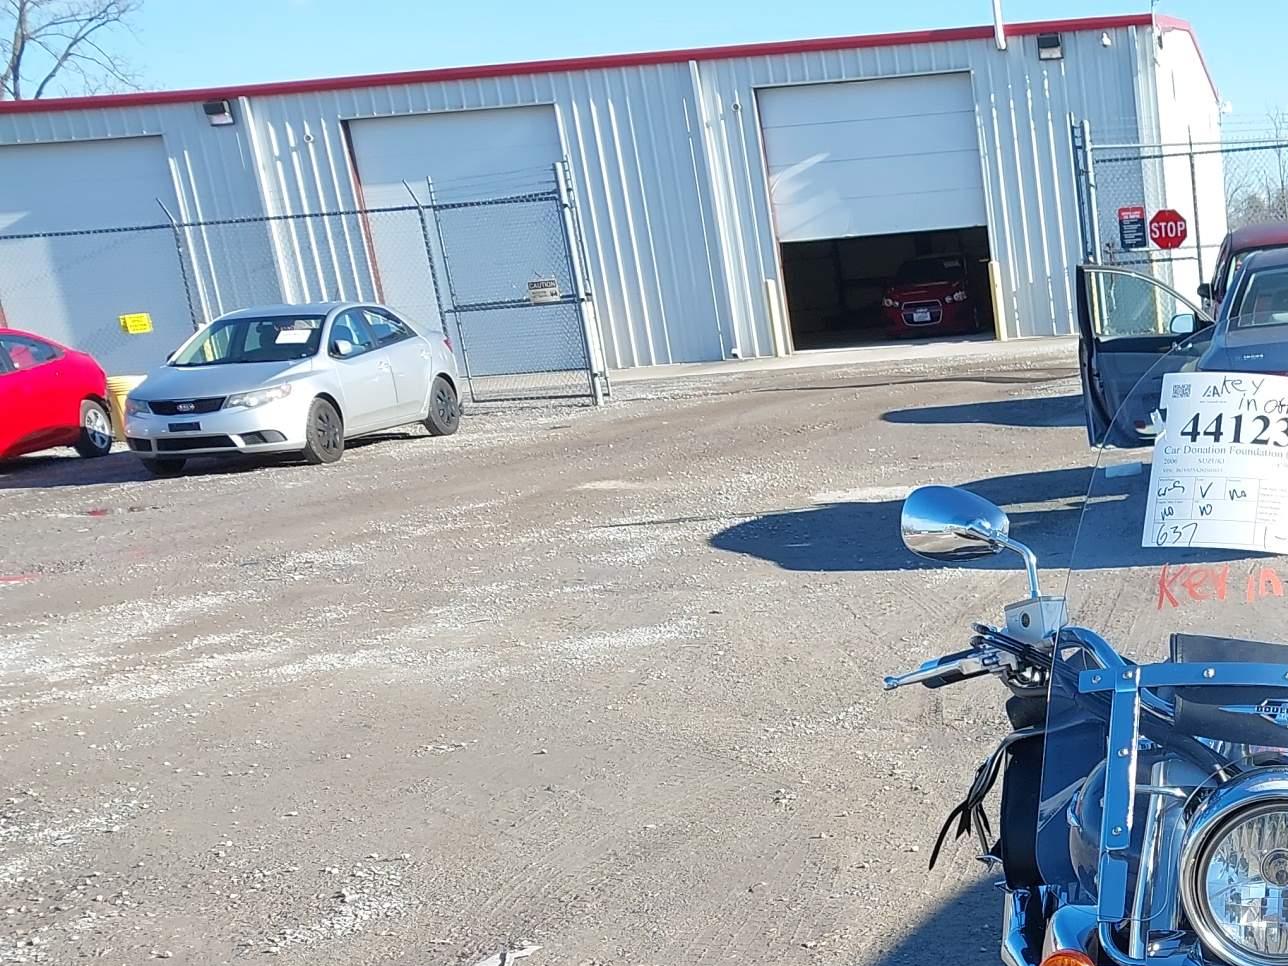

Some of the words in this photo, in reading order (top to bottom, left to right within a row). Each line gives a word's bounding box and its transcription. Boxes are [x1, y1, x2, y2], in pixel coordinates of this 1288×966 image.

[1151, 222, 1185, 238] STOP
[1164, 446, 1180, 455] Car
[1183, 445, 1226, 455] Donation
[1156, 523, 1198, 547] 637
